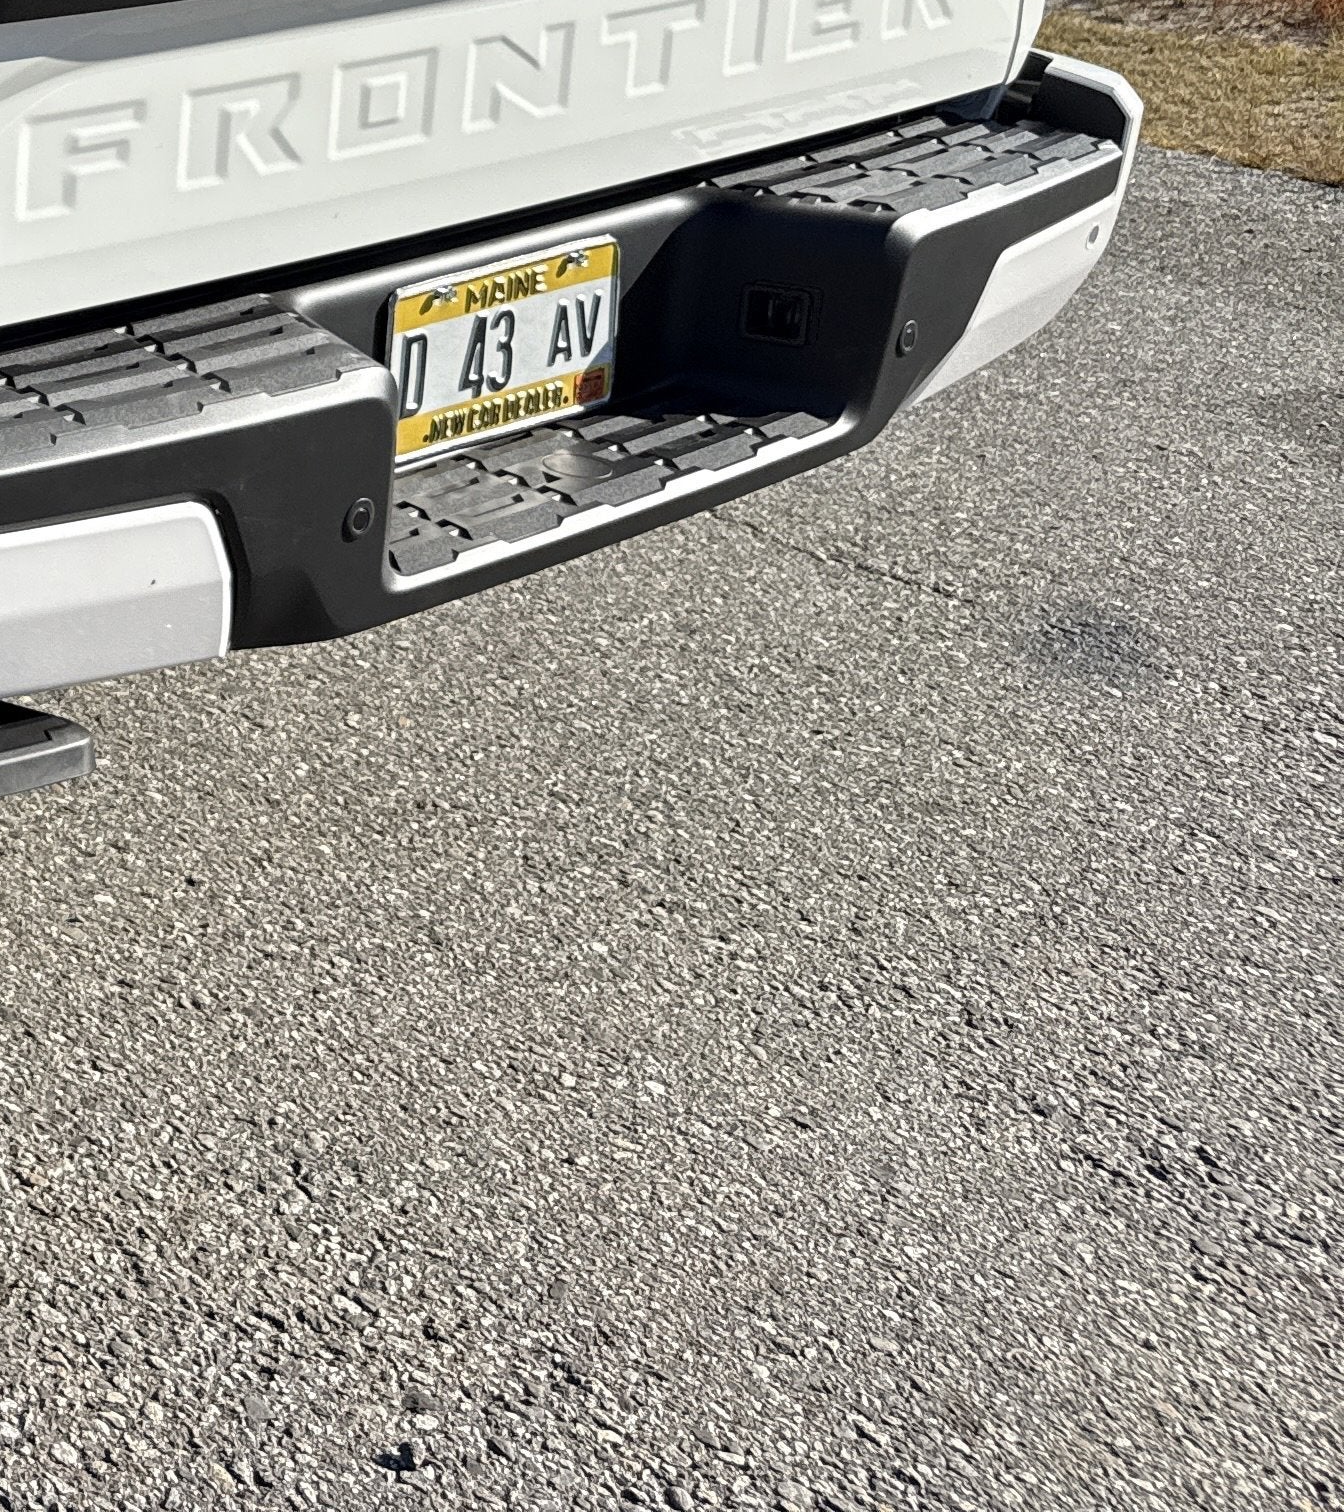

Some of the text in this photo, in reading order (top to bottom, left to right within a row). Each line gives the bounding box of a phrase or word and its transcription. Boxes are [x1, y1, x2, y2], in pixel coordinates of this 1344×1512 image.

[463, 264, 549, 314] MAINE
[457, 303, 516, 399] 43
[546, 288, 605, 368] AV
